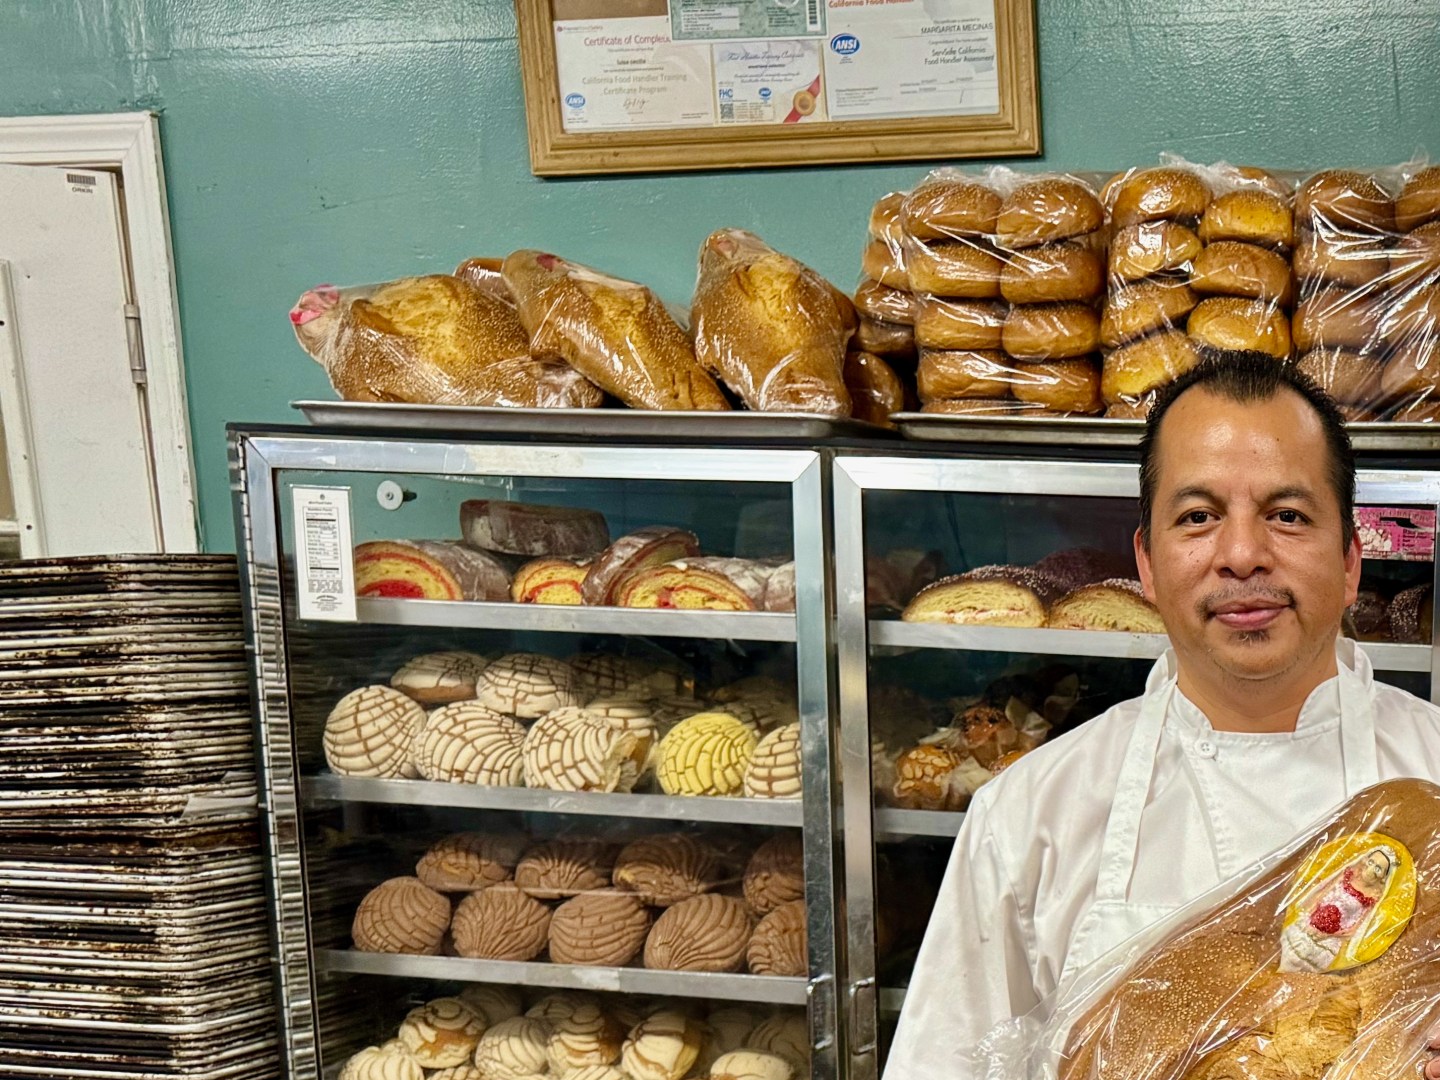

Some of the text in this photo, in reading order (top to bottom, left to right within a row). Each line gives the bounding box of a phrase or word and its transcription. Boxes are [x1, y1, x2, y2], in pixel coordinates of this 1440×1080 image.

[583, 36, 623, 47] Certificate
[624, 35, 632, 45] of
[835, 39, 857, 50] ANSI
[582, 73, 687, 85] California Food Handler Training
[603, 85, 668, 95] Certificate Program
